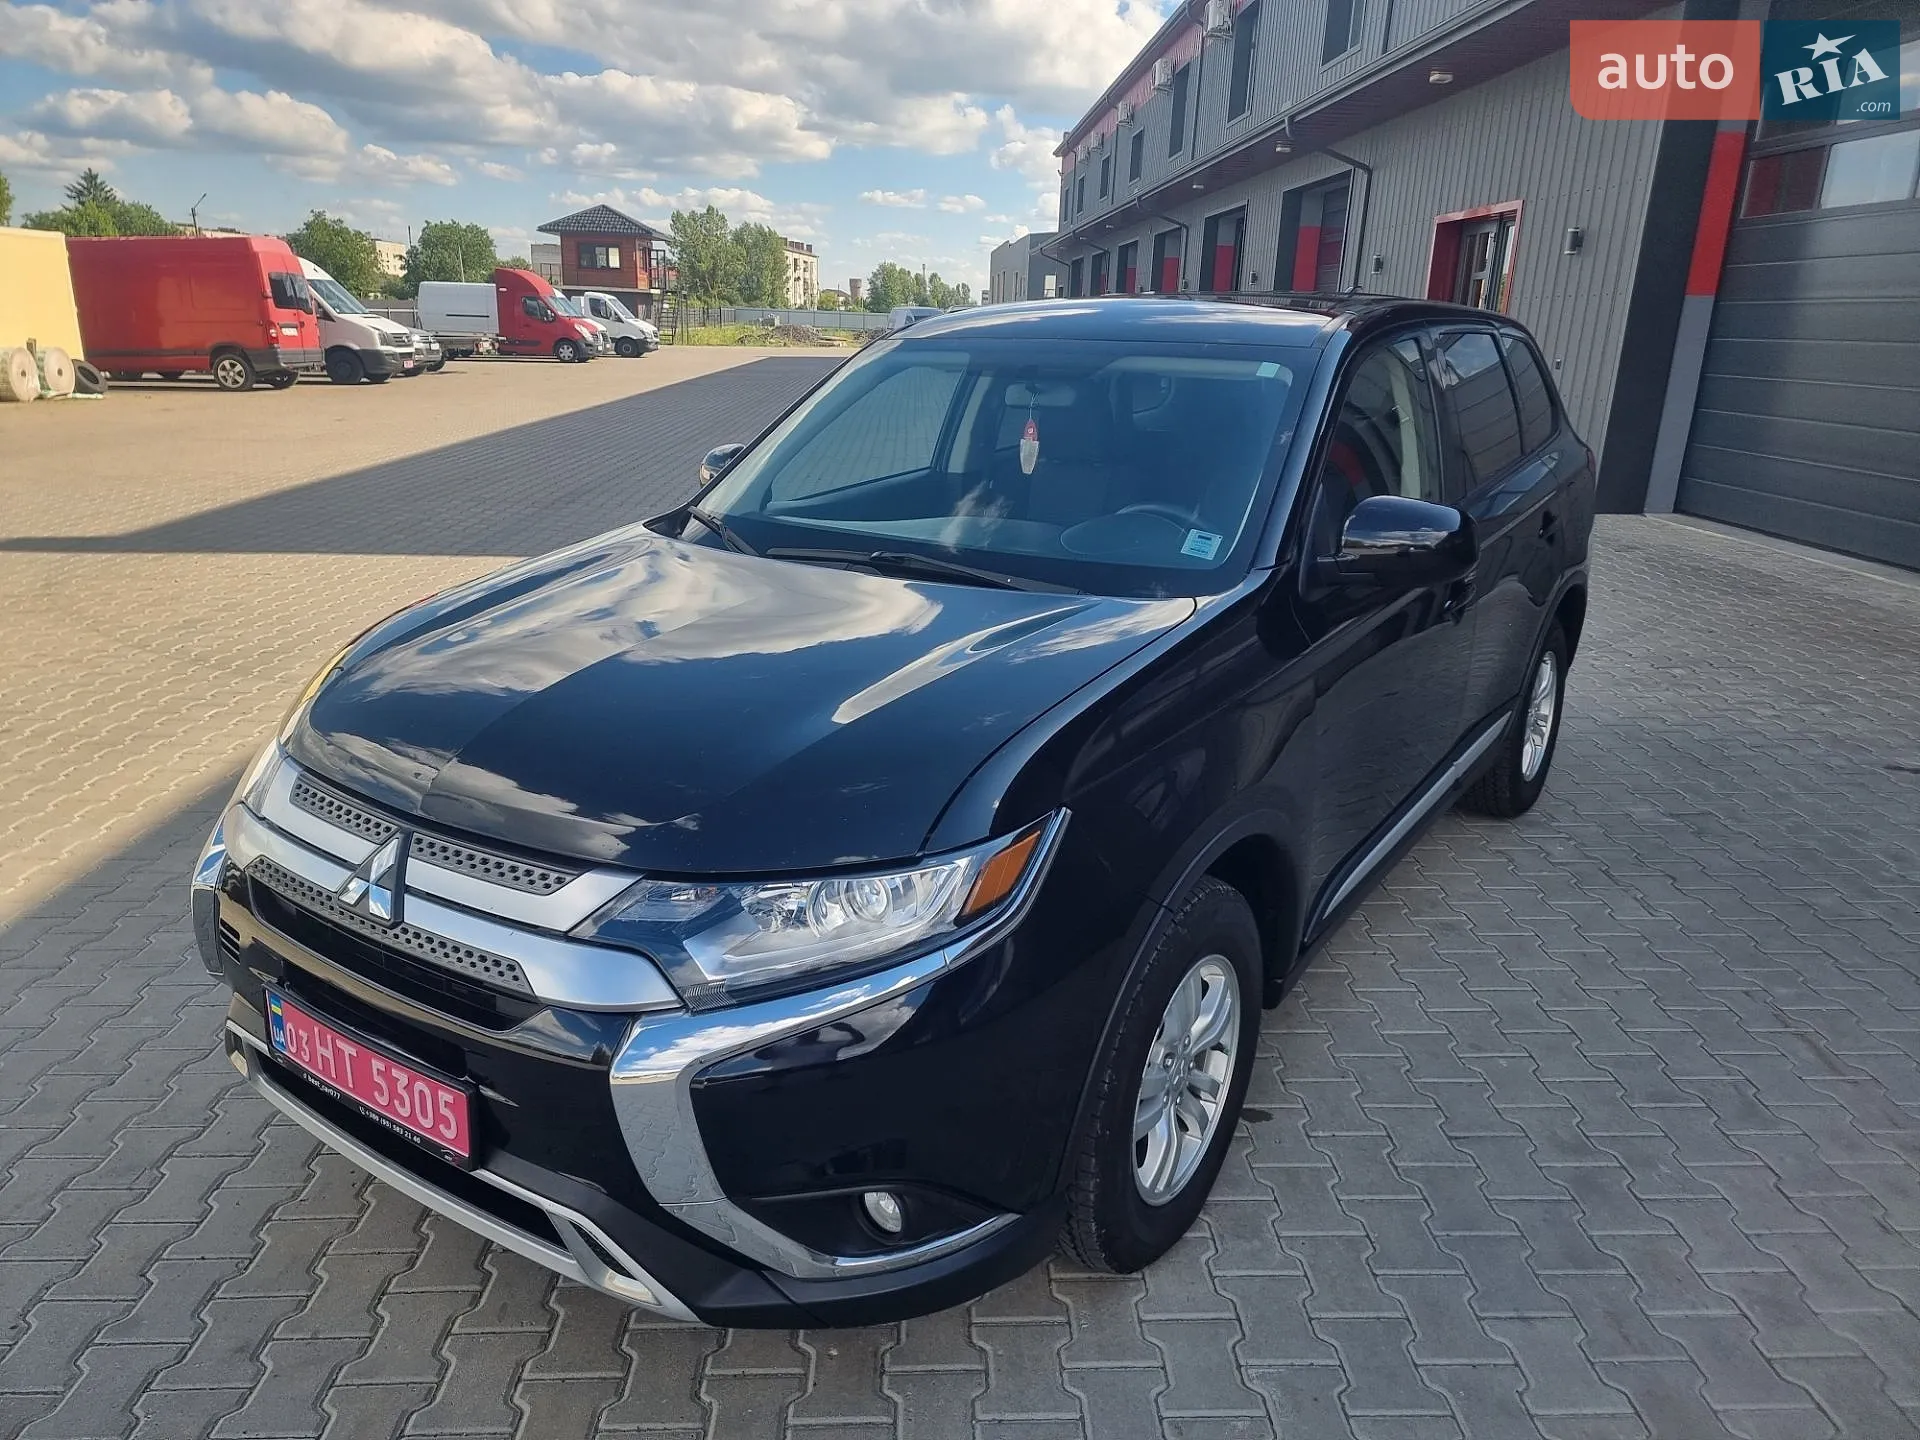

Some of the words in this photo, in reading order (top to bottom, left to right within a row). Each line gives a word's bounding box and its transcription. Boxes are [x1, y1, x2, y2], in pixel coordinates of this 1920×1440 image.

[274, 1027, 286, 1046] UA
[314, 1026, 358, 1089] HT
[371, 1058, 458, 1140] 5305
